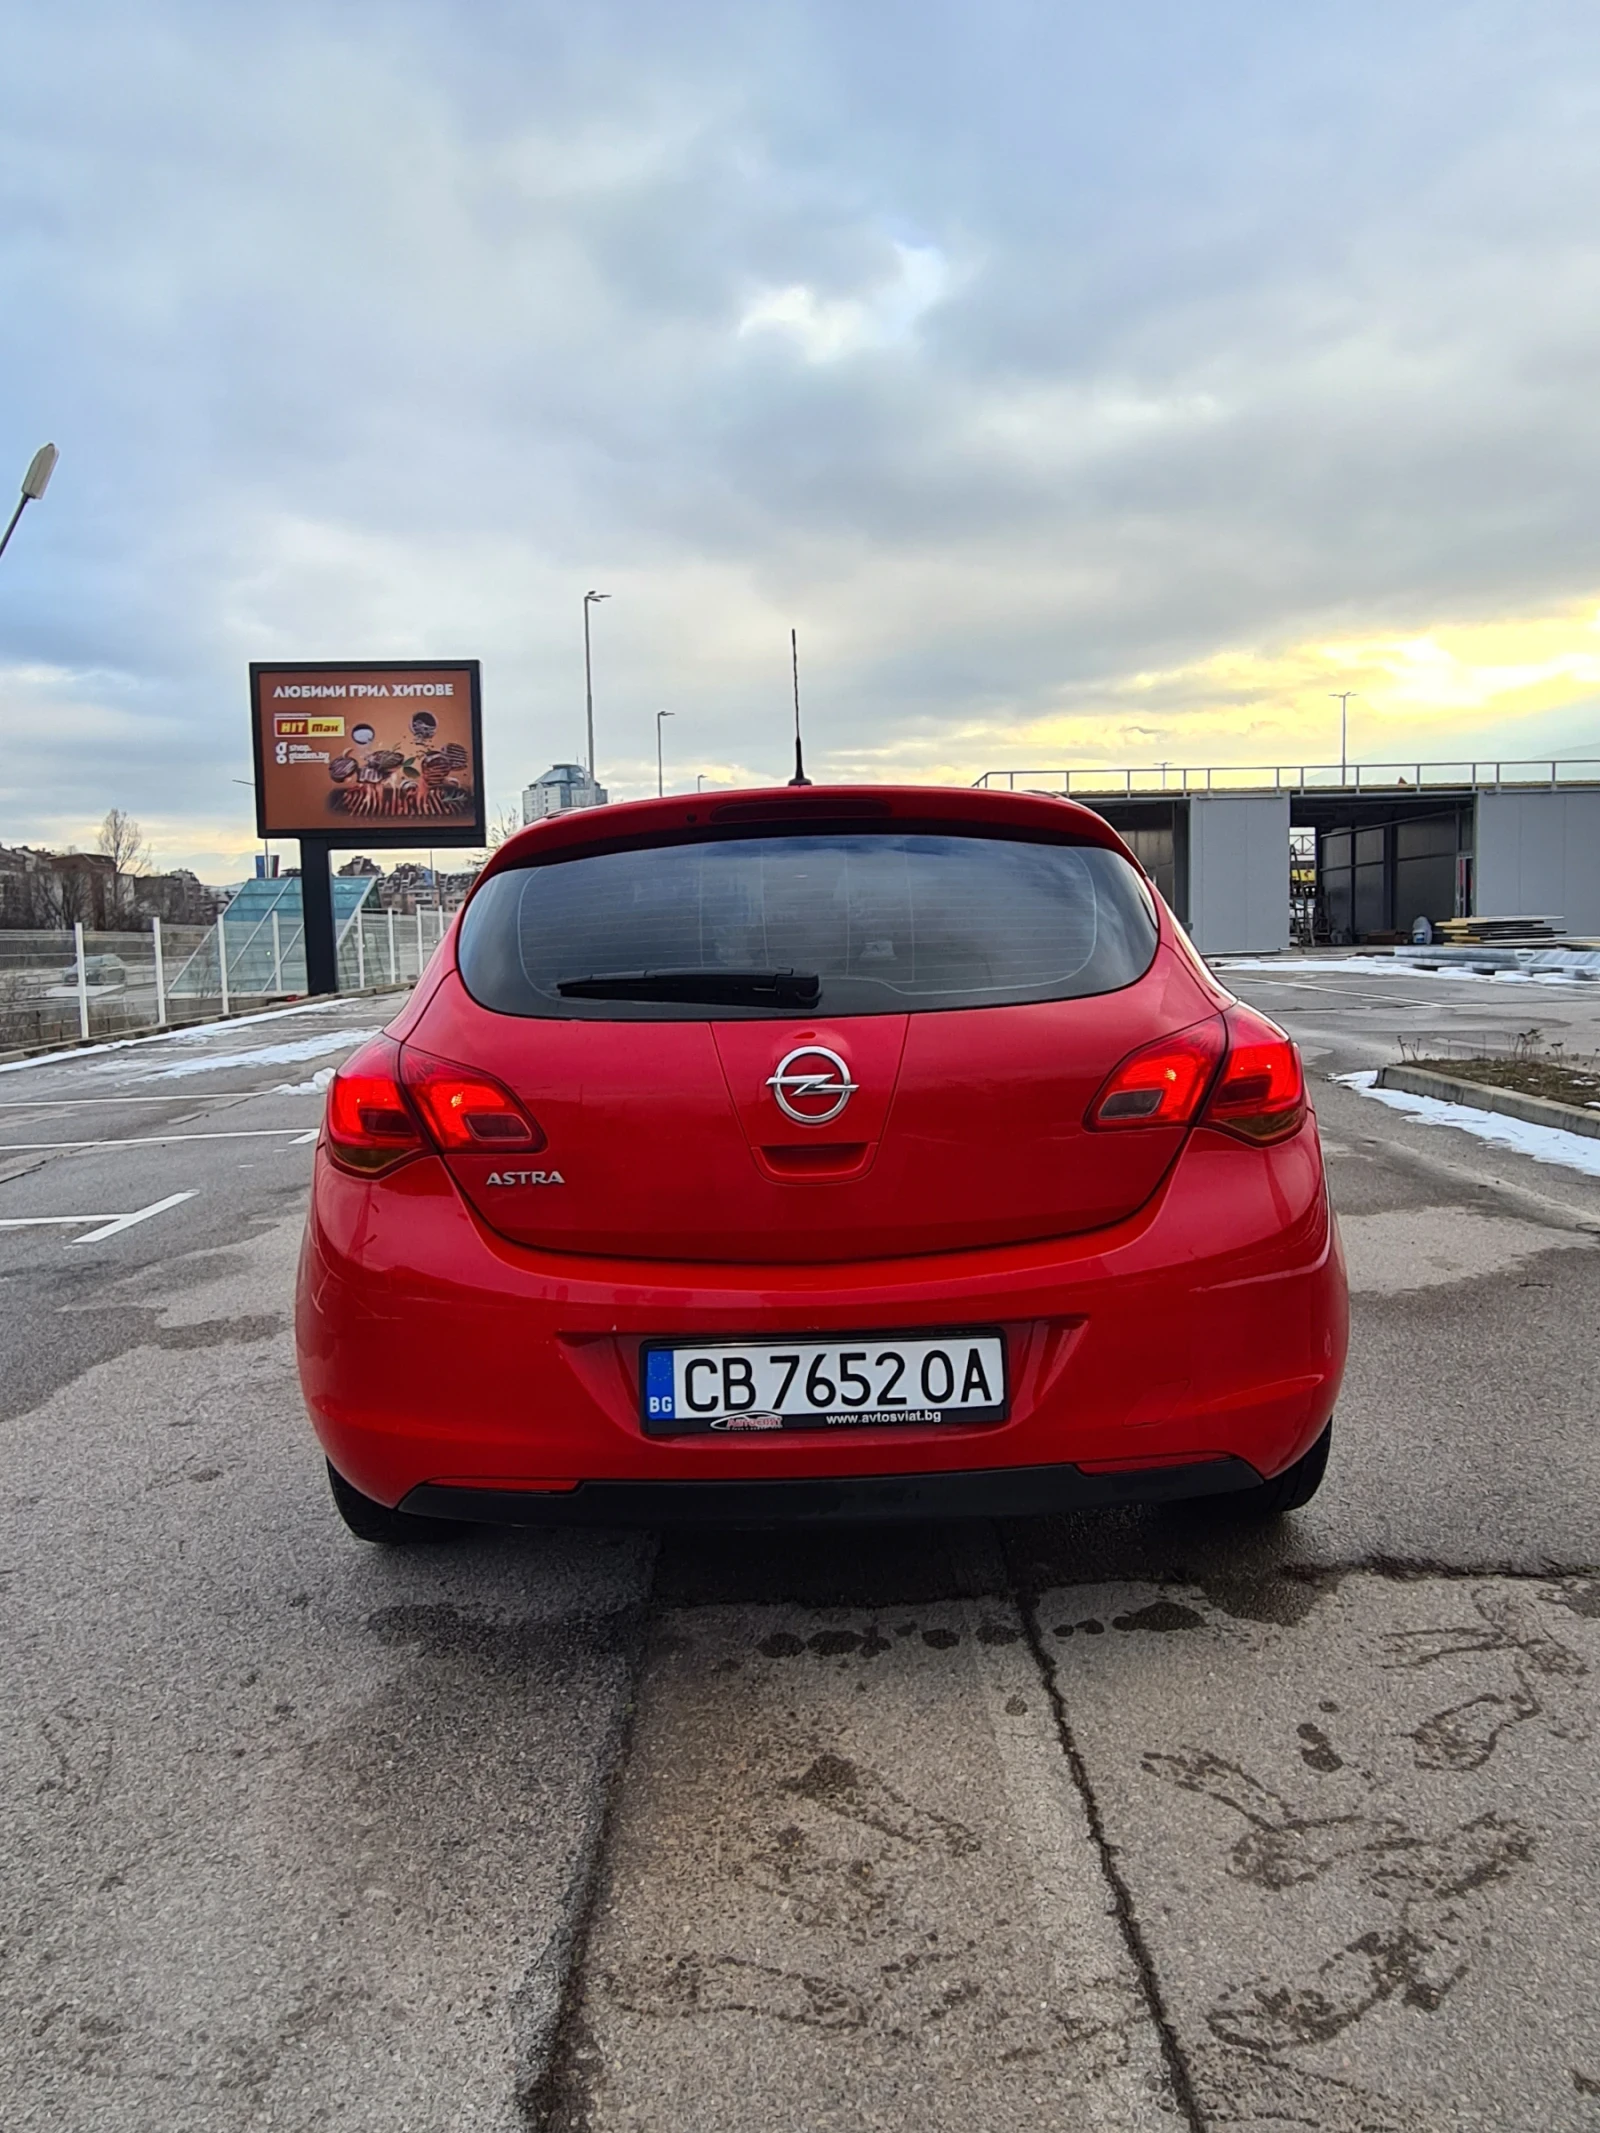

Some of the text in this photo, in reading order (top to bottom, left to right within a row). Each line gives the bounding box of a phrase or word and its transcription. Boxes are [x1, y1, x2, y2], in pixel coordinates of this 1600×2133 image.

[273, 684, 454, 698] ЛЮБИМИ ГРИЛ ХИТОВЕ
[281, 721, 305, 733] HIT
[486, 1170, 566, 1185] ASTRA
[649, 1396, 673, 1413] BG
[826, 1409, 942, 1425] www.avtosviat.bg
